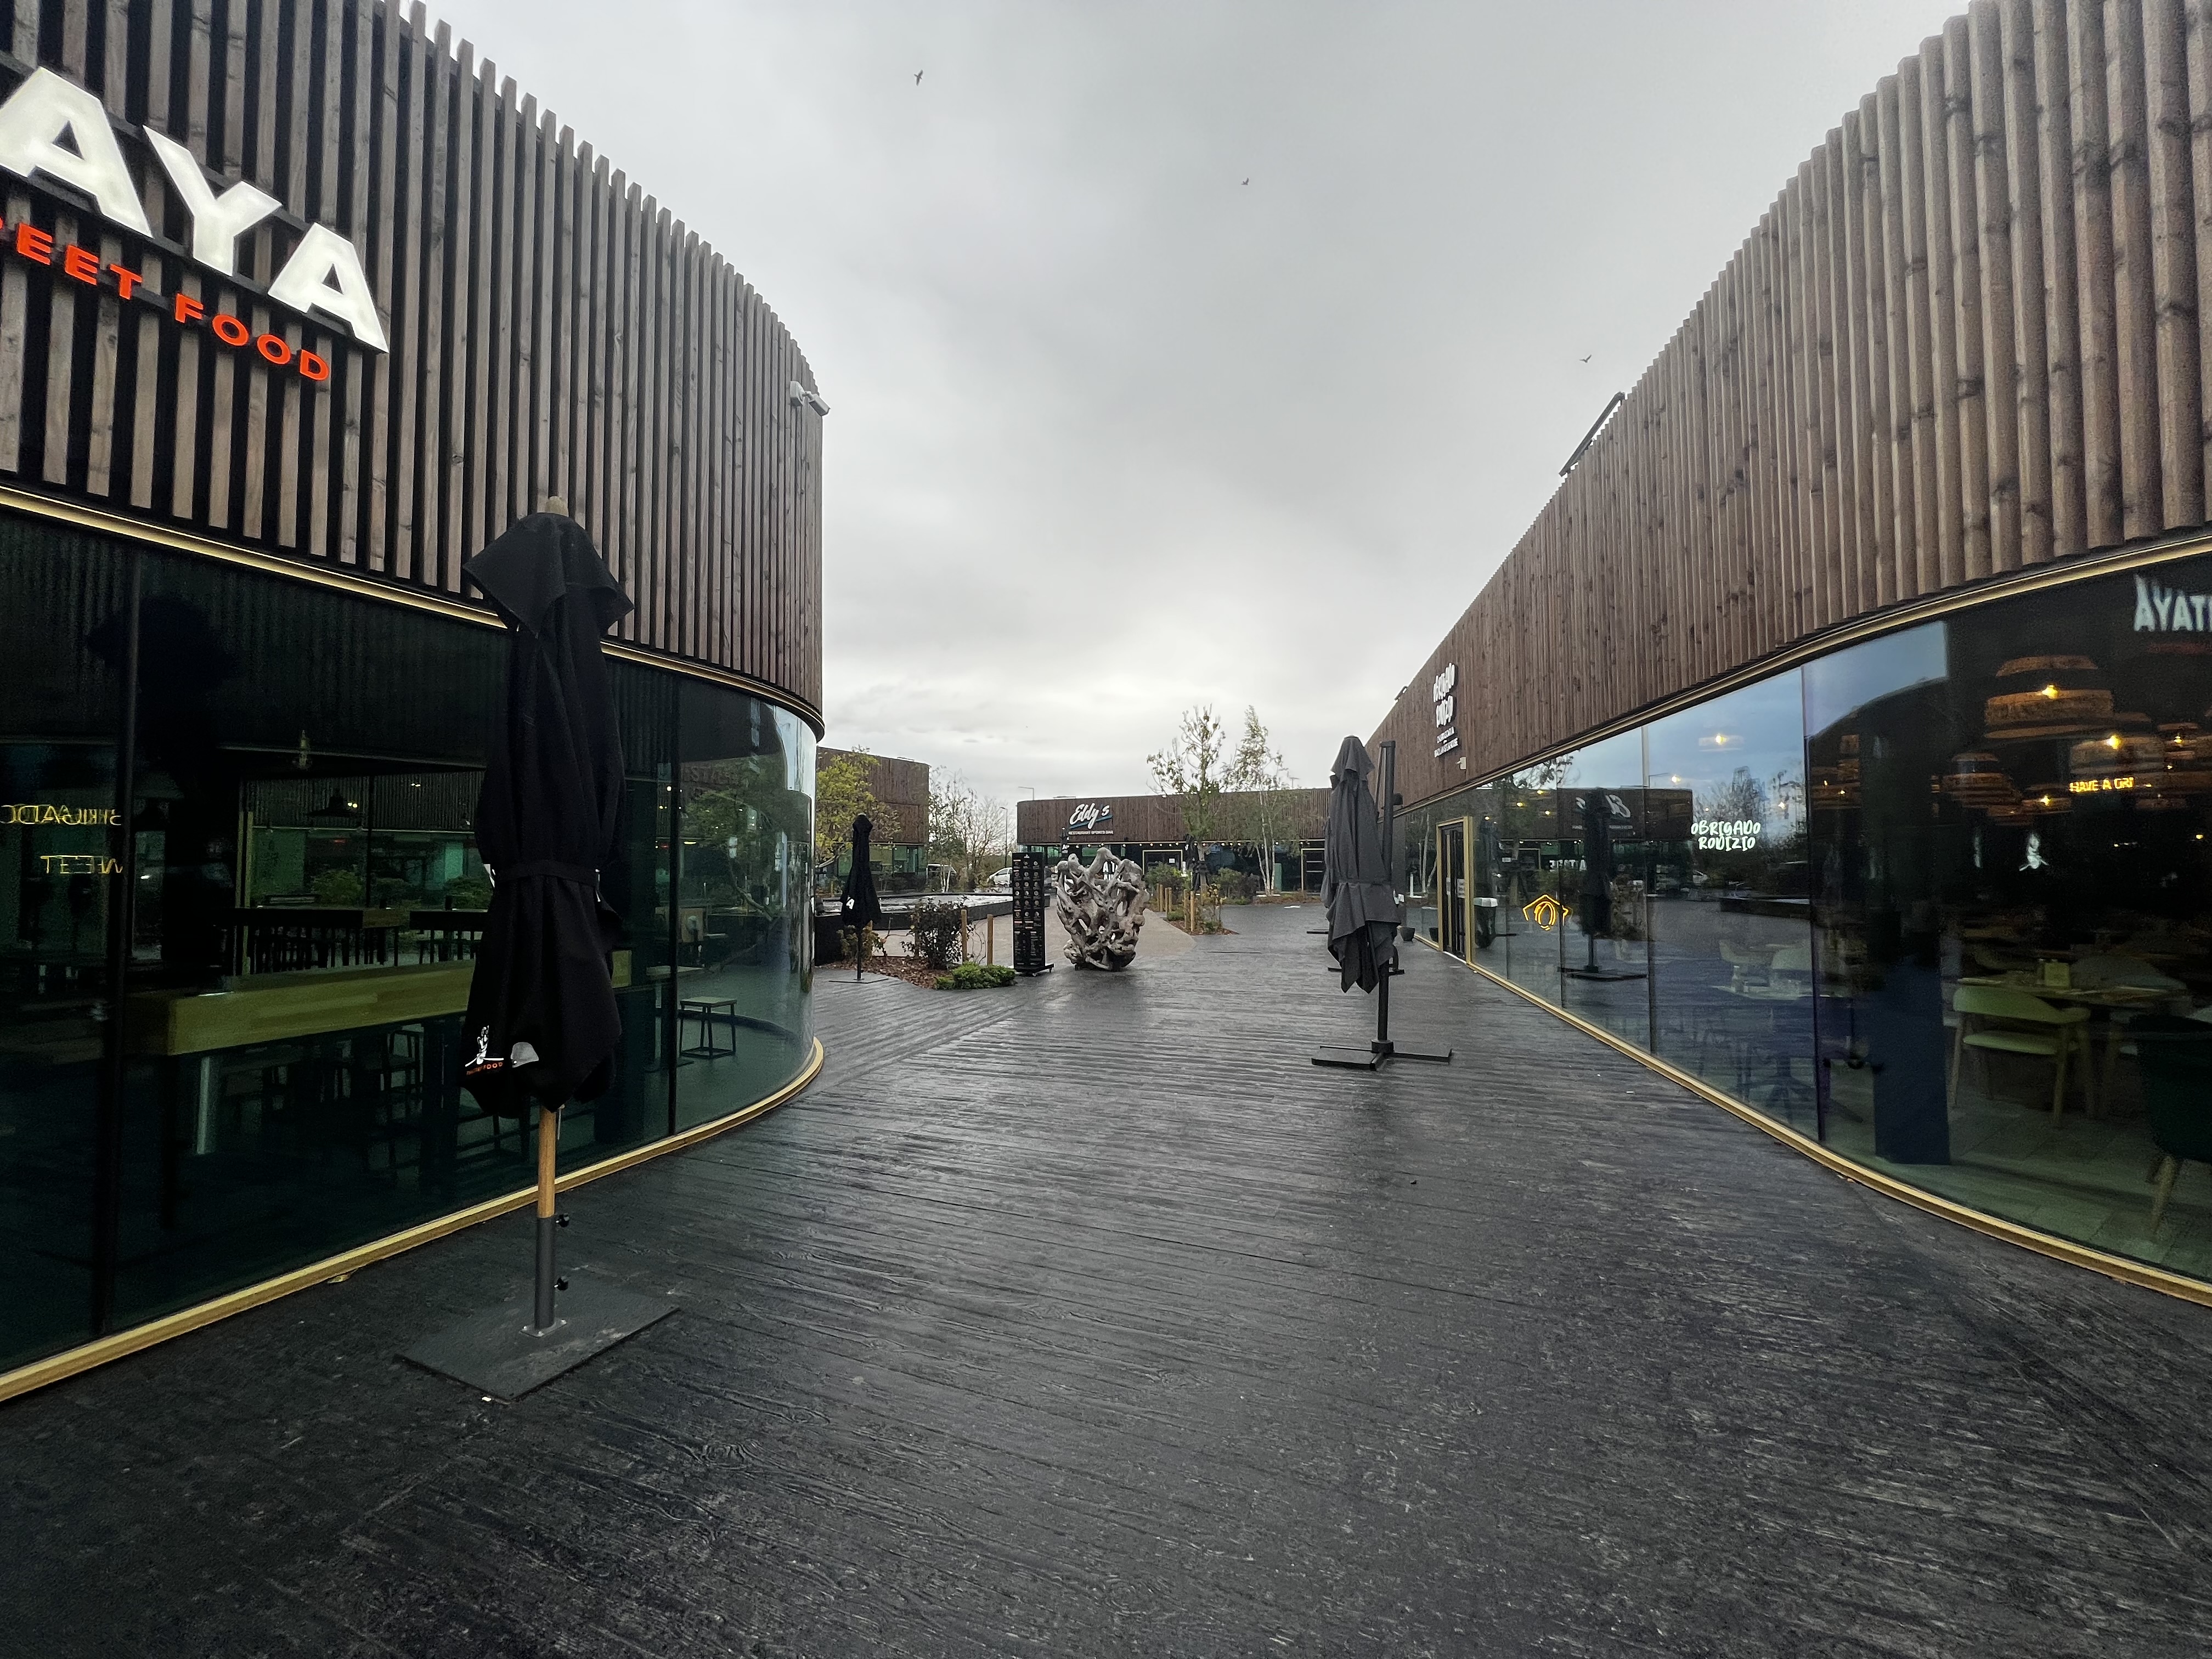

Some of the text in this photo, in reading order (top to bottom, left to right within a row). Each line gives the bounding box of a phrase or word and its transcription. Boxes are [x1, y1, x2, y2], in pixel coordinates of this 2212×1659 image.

[0, 66, 390, 353] AYA
[0, 218, 329, 381] EET FOOD
[2069, 780, 2099, 792] HAVE
[2102, 779, 2112, 790] A
[1069, 803, 1110, 830] Eddy's
[1691, 820, 1761, 836] OBRIGADO
[1698, 836, 1756, 851] RODIZIO
